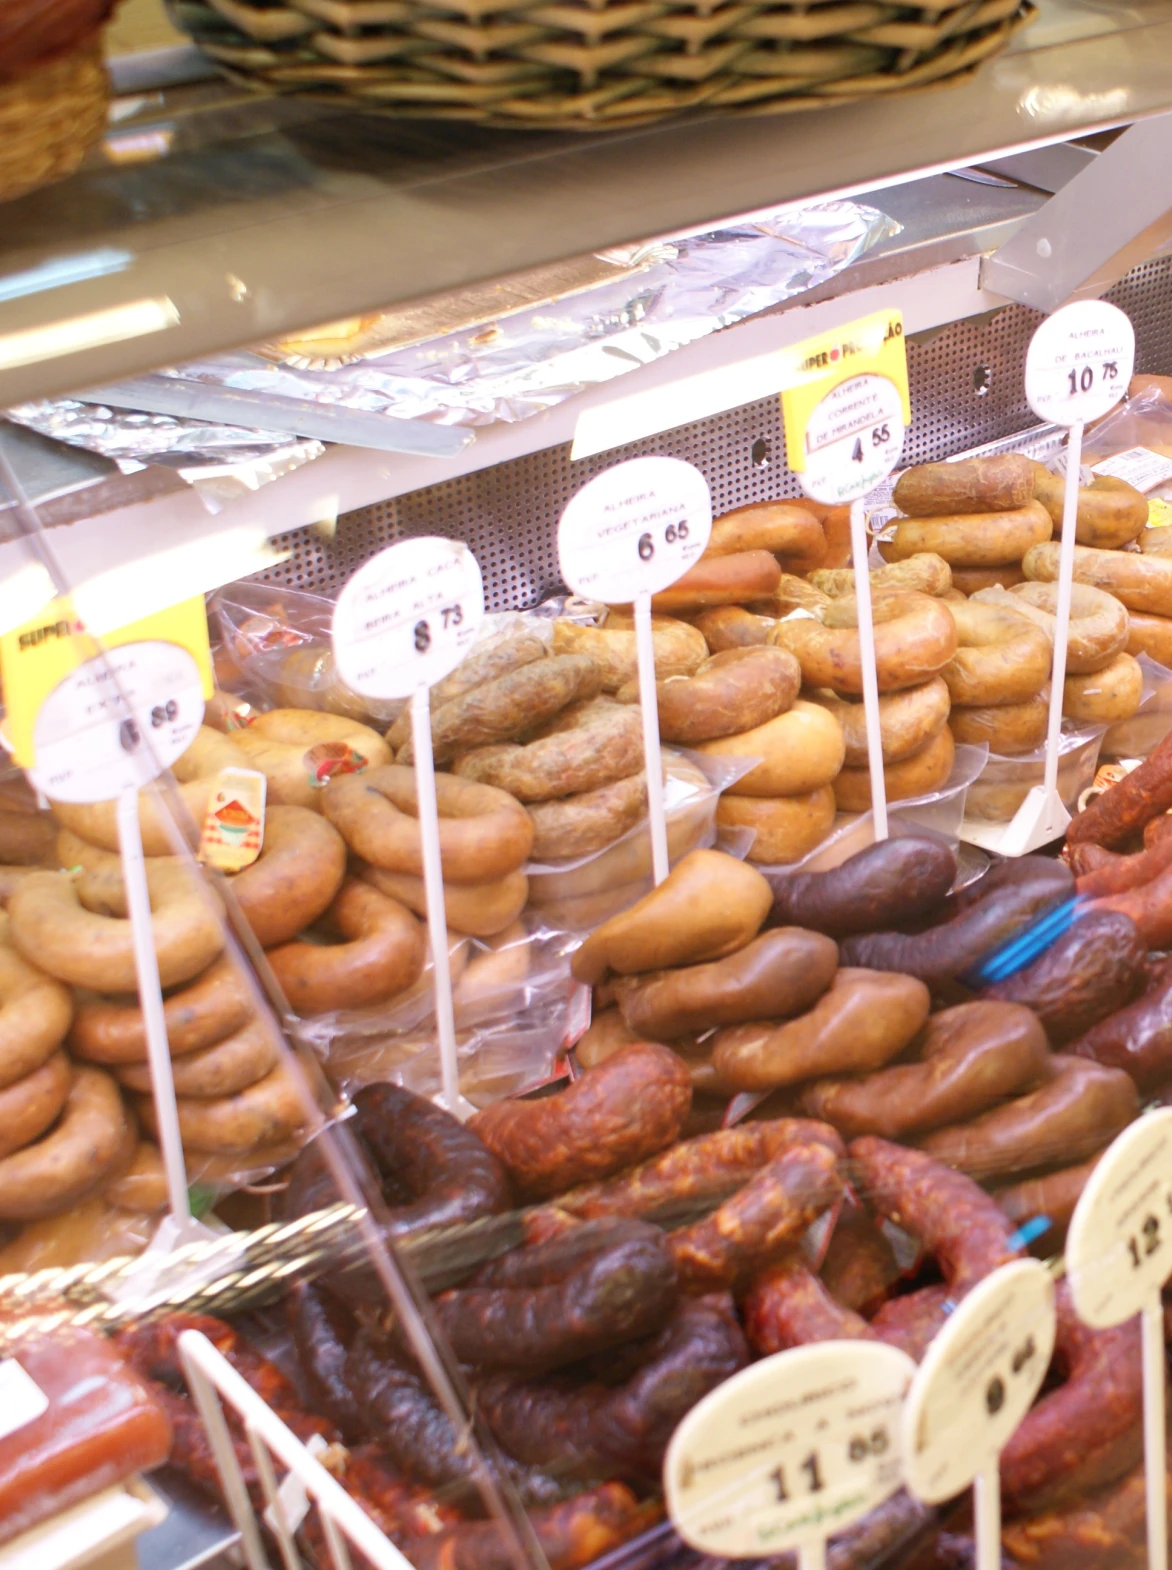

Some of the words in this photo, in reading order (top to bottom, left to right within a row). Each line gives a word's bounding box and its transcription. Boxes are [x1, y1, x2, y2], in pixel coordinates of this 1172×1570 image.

[1068, 328, 1105, 340] ALHEIRA
[1055, 355, 1067, 364] DE
[831, 378, 869, 400] ALHEIRA
[1067, 365, 1094, 396] 10
[827, 393, 878, 421] CORRENTE
[816, 431, 829, 445] DE
[832, 407, 885, 438] MIRANDELA
[851, 437, 864, 463] 4
[603, 490, 657, 513] ALHEIRA
[596, 502, 687, 539] VEGETARIANA
[638, 532, 655, 562] 6
[664, 518, 690, 544] 65
[366, 576, 417, 601] ALHEIRA
[413, 591, 443, 610] ALTA
[414, 619, 431, 654] 8
[768, 1449, 824, 1504] 11
